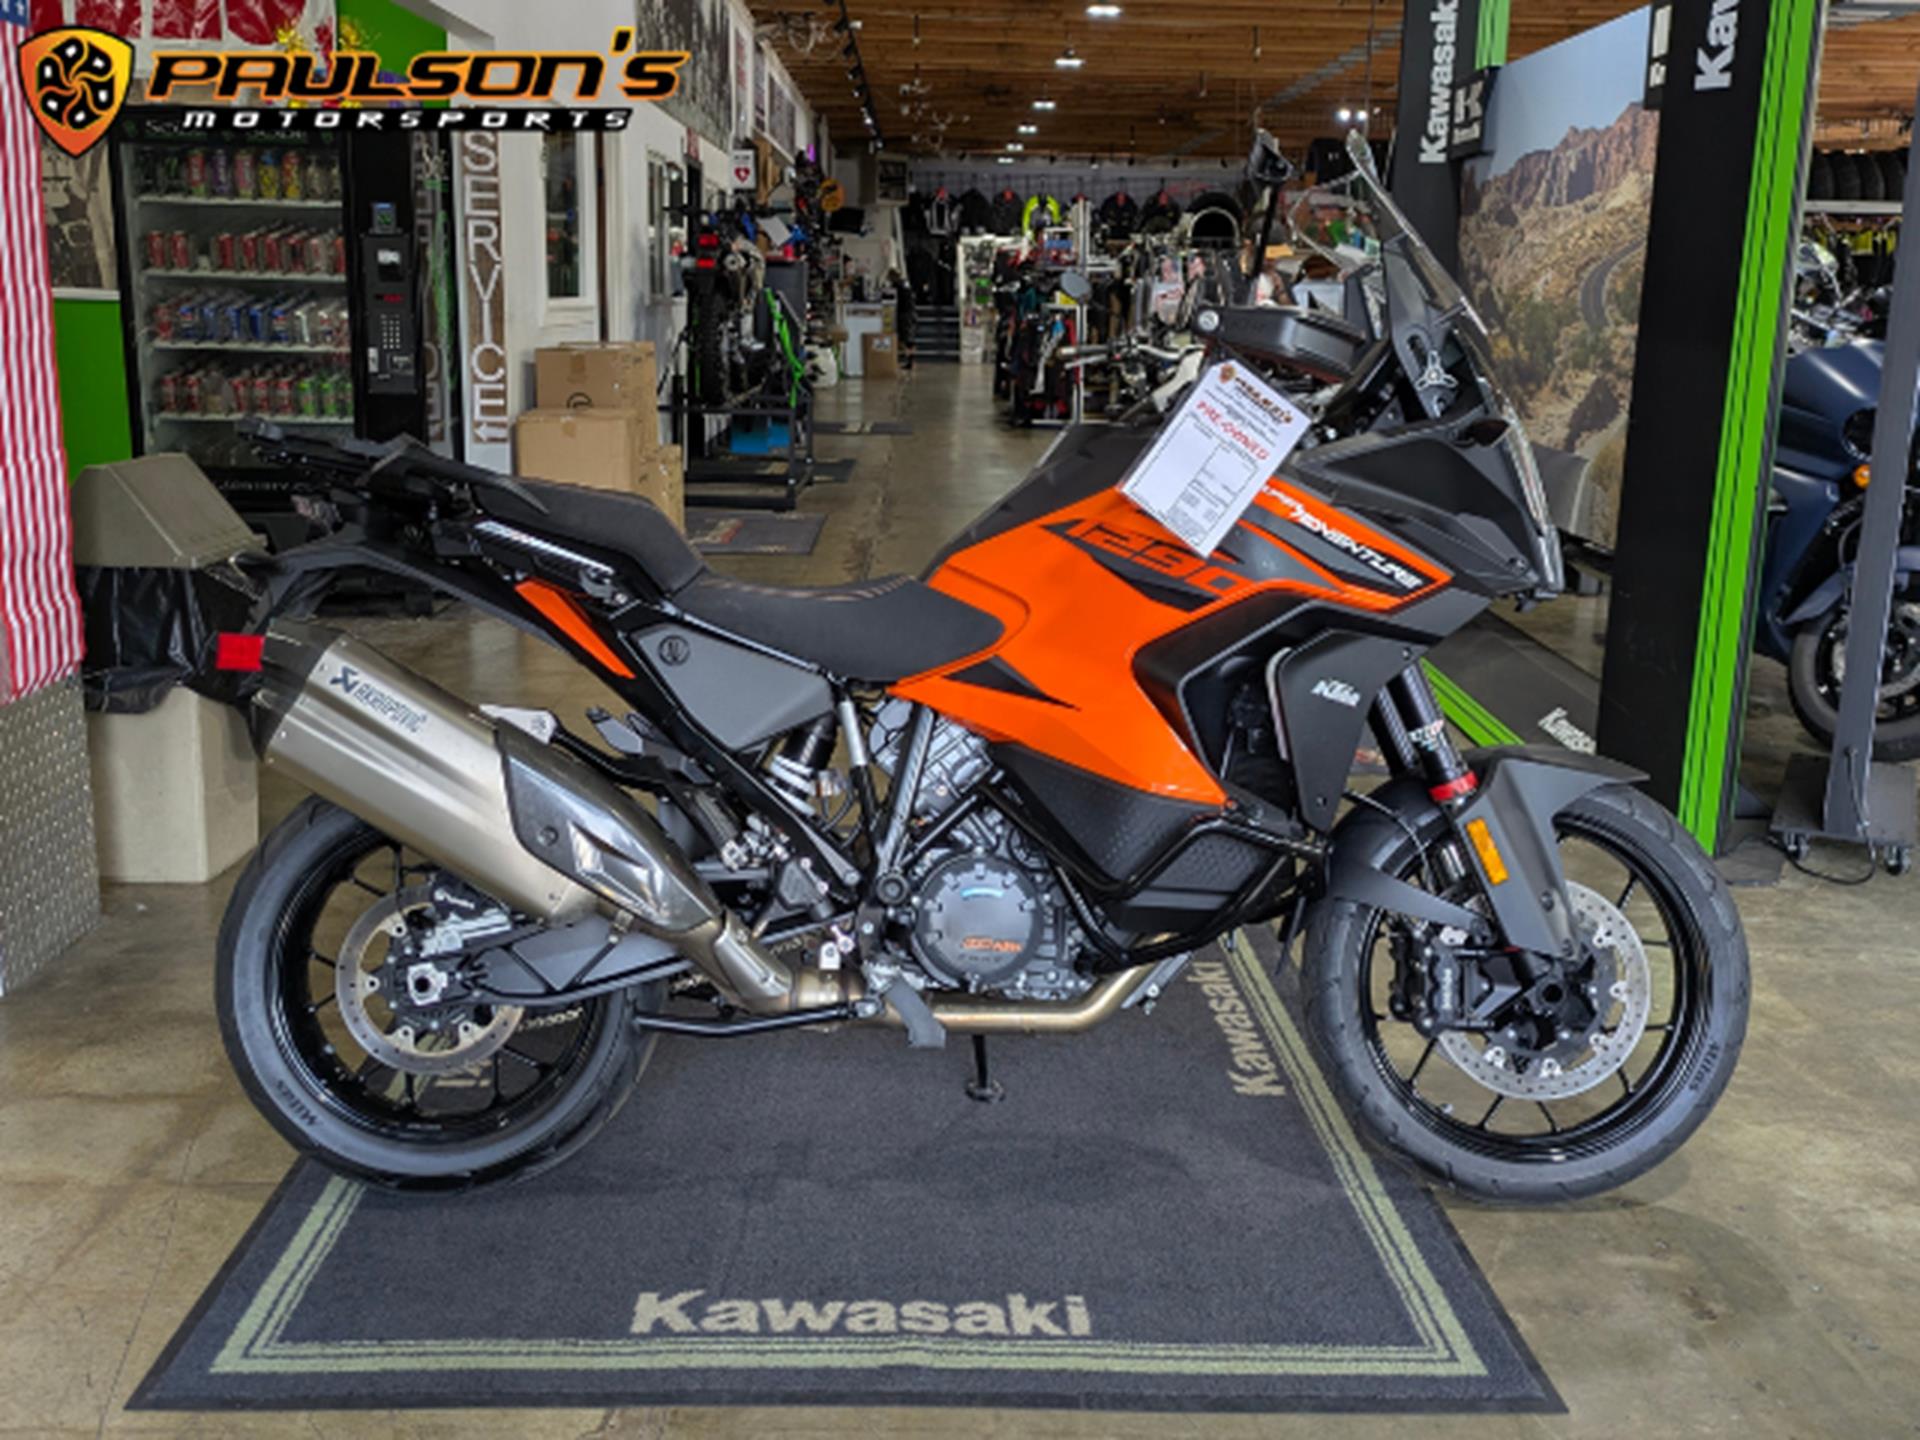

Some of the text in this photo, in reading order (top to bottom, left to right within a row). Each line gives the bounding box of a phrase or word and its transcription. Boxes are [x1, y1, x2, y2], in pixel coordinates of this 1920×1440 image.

[462, 131, 508, 422] SERVICE
[1195, 400, 1270, 461] PRE-OWNED
[1310, 679, 1362, 708] KTM
[1186, 962, 1287, 1095] Kawasaki
[629, 1289, 1092, 1336] Kawasaki
